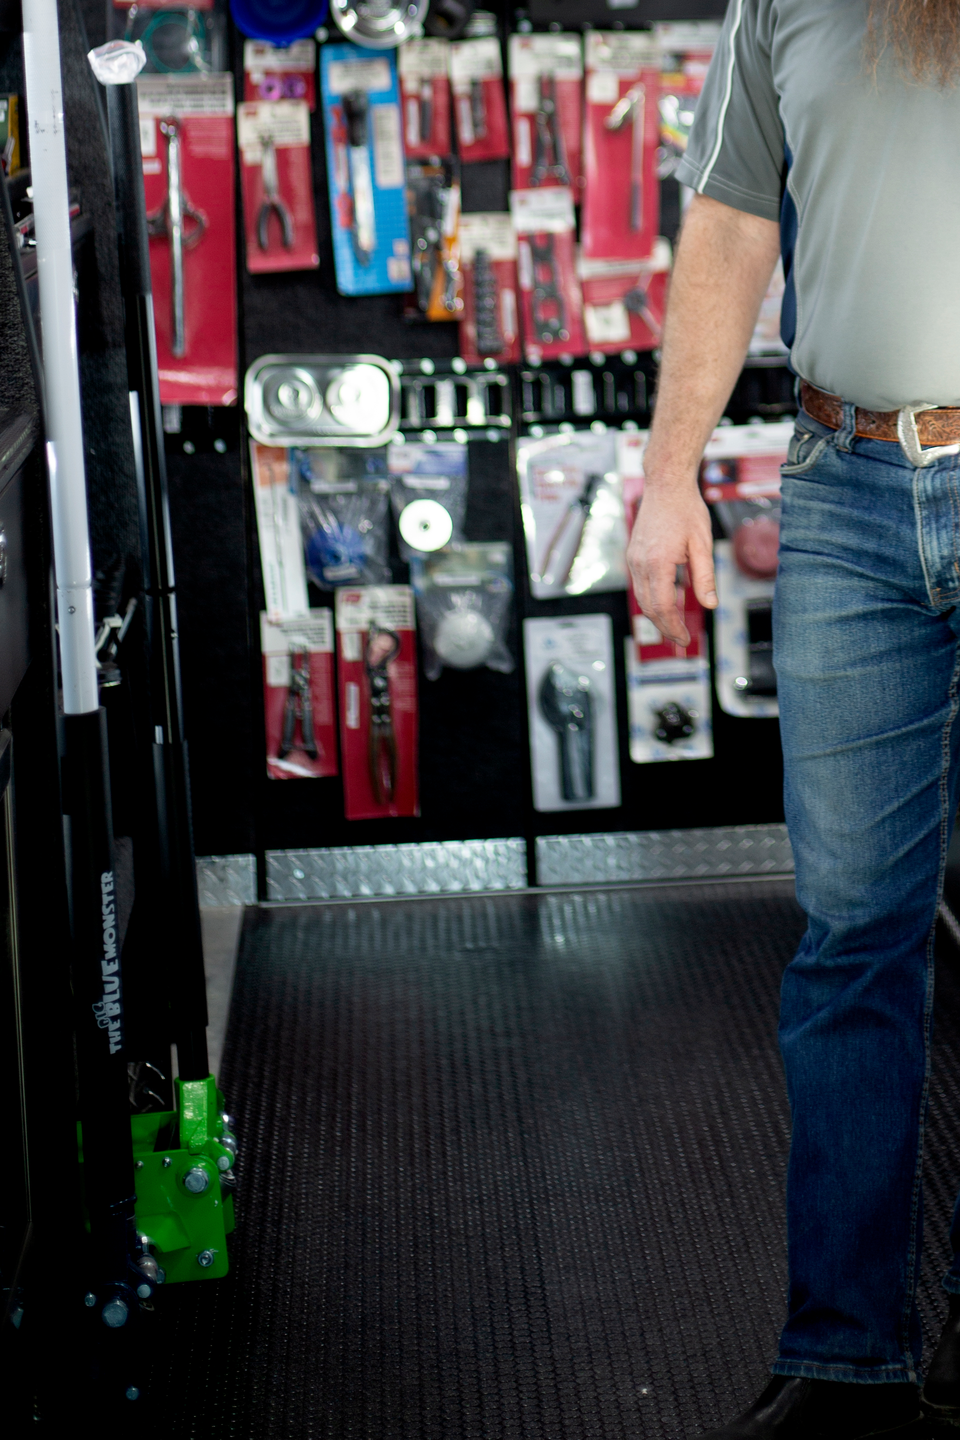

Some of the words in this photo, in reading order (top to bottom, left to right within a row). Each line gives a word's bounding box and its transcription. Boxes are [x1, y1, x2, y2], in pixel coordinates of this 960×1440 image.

[101, 871, 117, 960] MONSTER
[101, 959, 121, 1018] BLUE
[92, 1001, 111, 1028] BIG
[108, 1018, 122, 1054] THE
